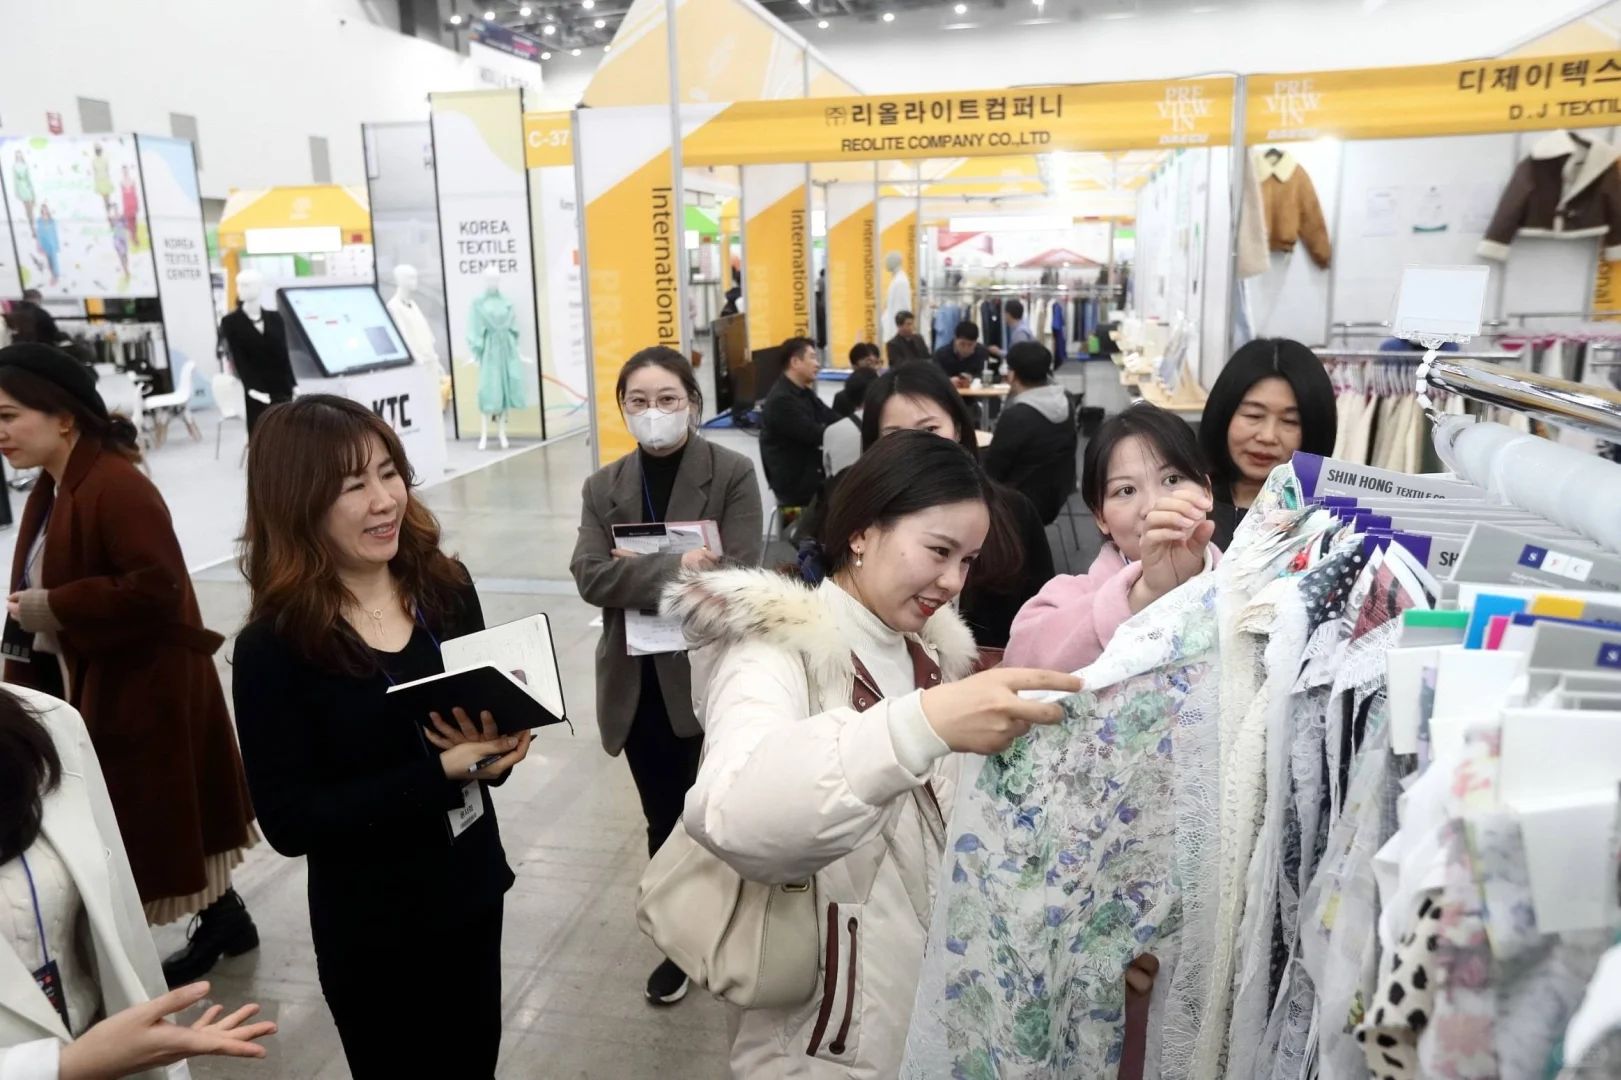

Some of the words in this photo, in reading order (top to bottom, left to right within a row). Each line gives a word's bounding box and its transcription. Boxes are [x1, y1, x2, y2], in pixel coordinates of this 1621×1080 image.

[1458, 58, 1621, 94] 디제이텍스
[1165, 85, 1204, 103] PRE
[1274, 78, 1316, 98] PRE
[1157, 99, 1214, 118] VIEW
[1264, 93, 1325, 113] VIEW
[1172, 115, 1196, 132] IN
[1280, 108, 1305, 126] IN
[528, 129, 570, 148] C-37
[841, 136, 905, 152] REOLITE
[908, 133, 984, 150] COMPANY
[459, 220, 511, 235] KOREA
[457, 239, 517, 255] TEXTILE
[651, 187, 680, 345] International
[790, 209, 809, 316] International
[863, 219, 876, 300] International
[748, 265, 770, 349] PREVIE
[372, 394, 412, 428] KTC
[1327, 469, 1357, 486] SHIN
[1359, 475, 1393, 493] HONG
[1438, 551, 1459, 567] SH
